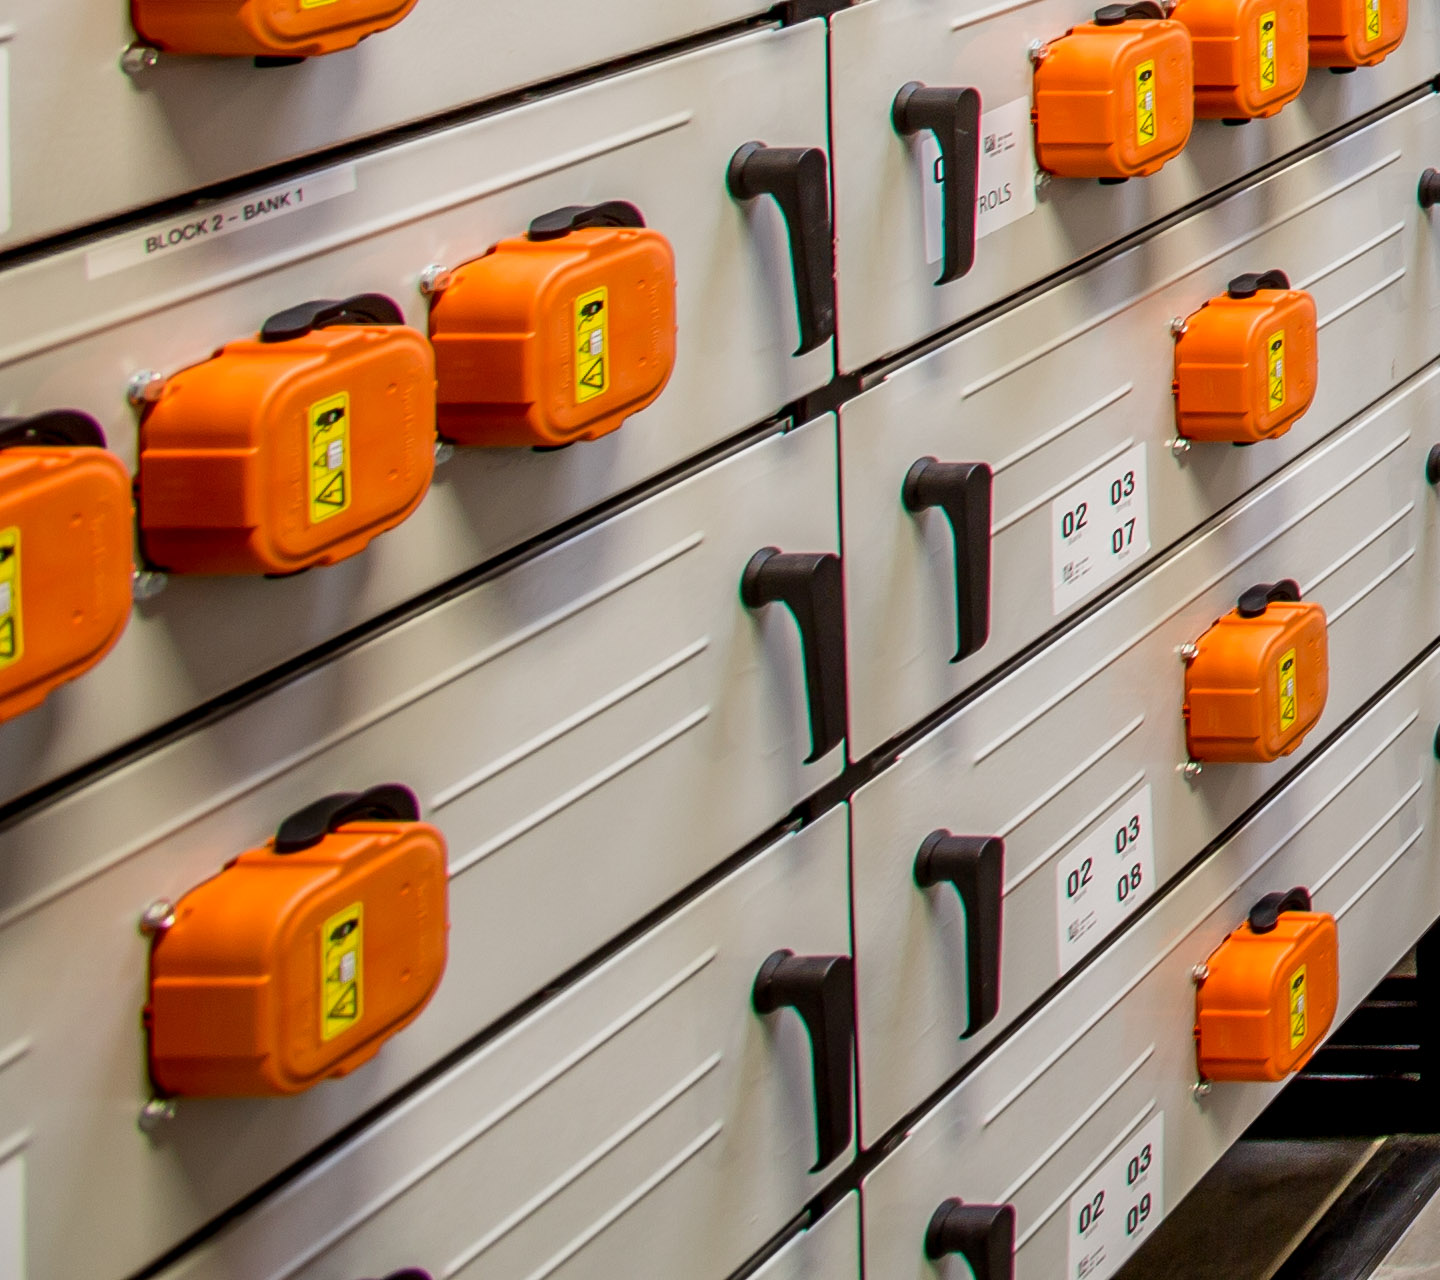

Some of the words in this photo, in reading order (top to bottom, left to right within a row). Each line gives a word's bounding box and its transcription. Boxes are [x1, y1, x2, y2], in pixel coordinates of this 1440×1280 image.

[146, 220, 208, 253] BLOCK
[212, 215, 223, 231] 2
[244, 193, 290, 220] BANK
[296, 188, 303, 201] 1
[1111, 470, 1135, 506] 03
[1062, 502, 1087, 539] 02
[1112, 517, 1136, 554] 07
[1115, 815, 1140, 854] 03
[1067, 857, 1093, 898] 02
[1117, 862, 1142, 902] 08
[1127, 1143, 1152, 1186] 03
[1079, 1190, 1105, 1234] 02
[1126, 1192, 1152, 1236] 09
